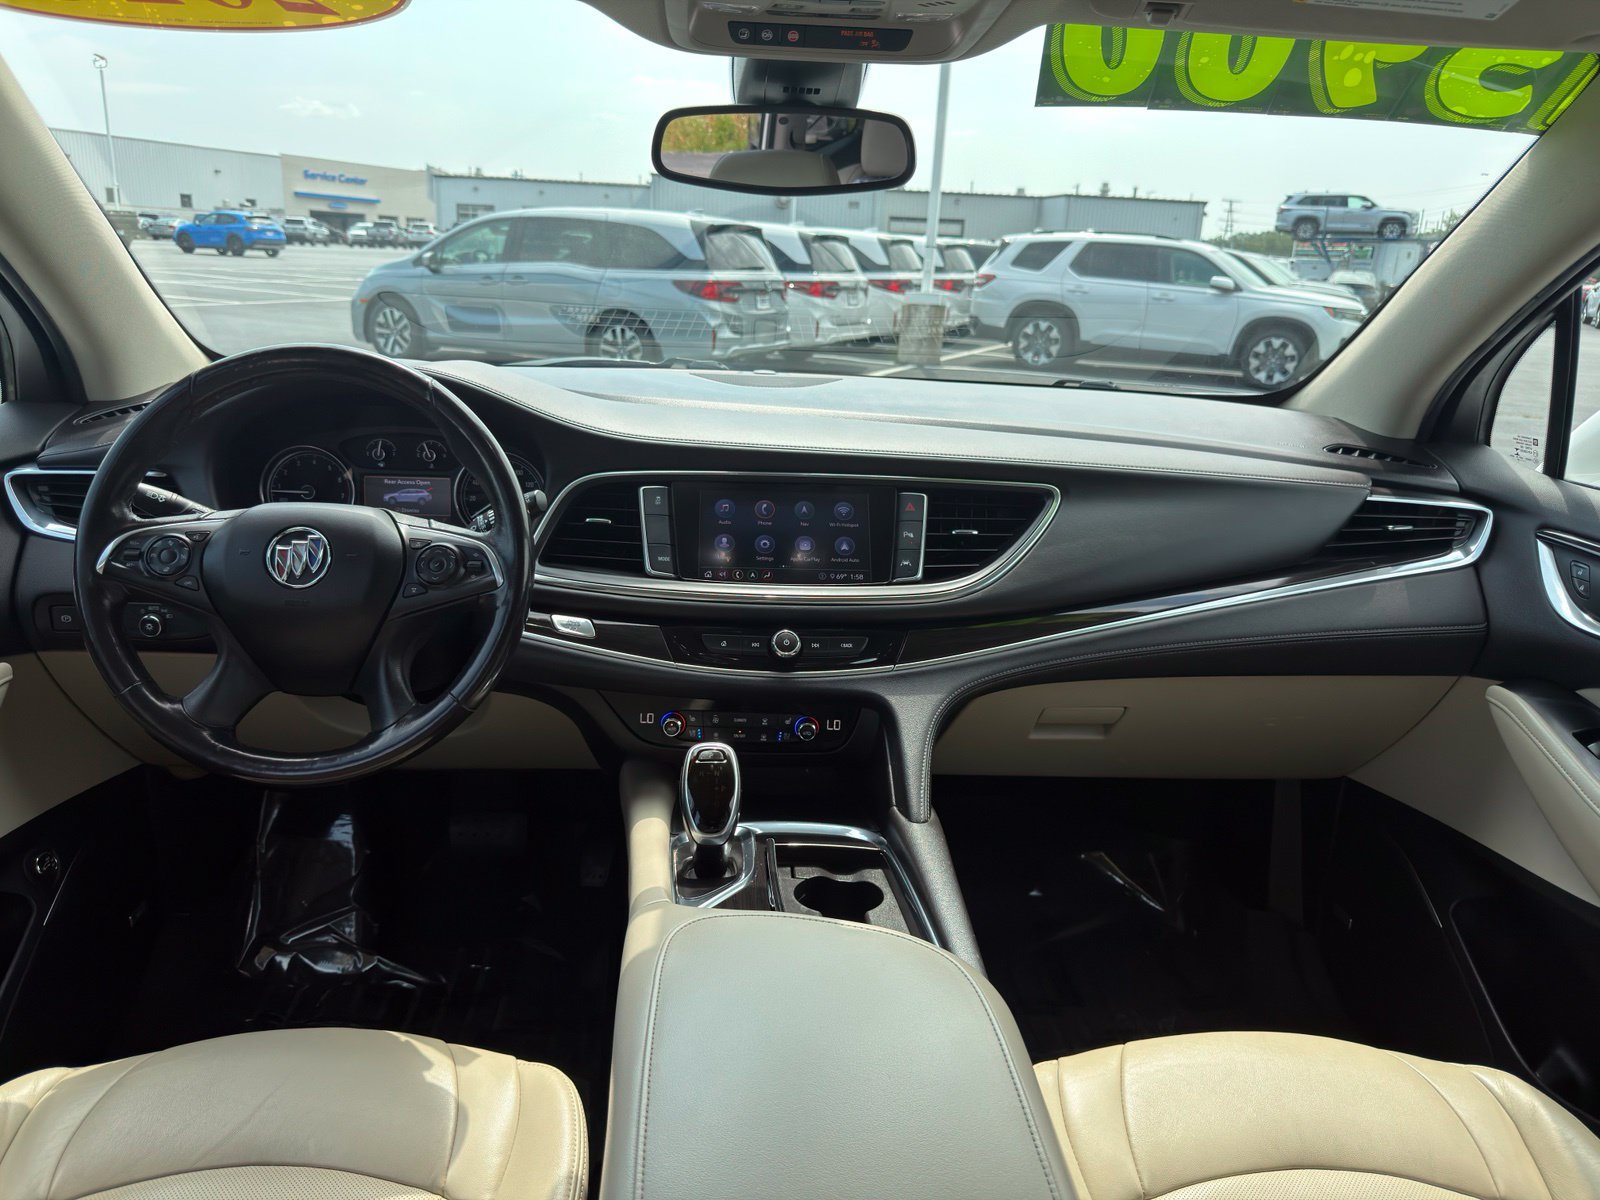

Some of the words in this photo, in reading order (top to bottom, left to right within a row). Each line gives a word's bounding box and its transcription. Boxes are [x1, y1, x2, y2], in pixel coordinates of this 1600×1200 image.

[303, 169, 337, 182] Service
[338, 174, 368, 185] Center
[803, 556, 821, 564] CarPlay
